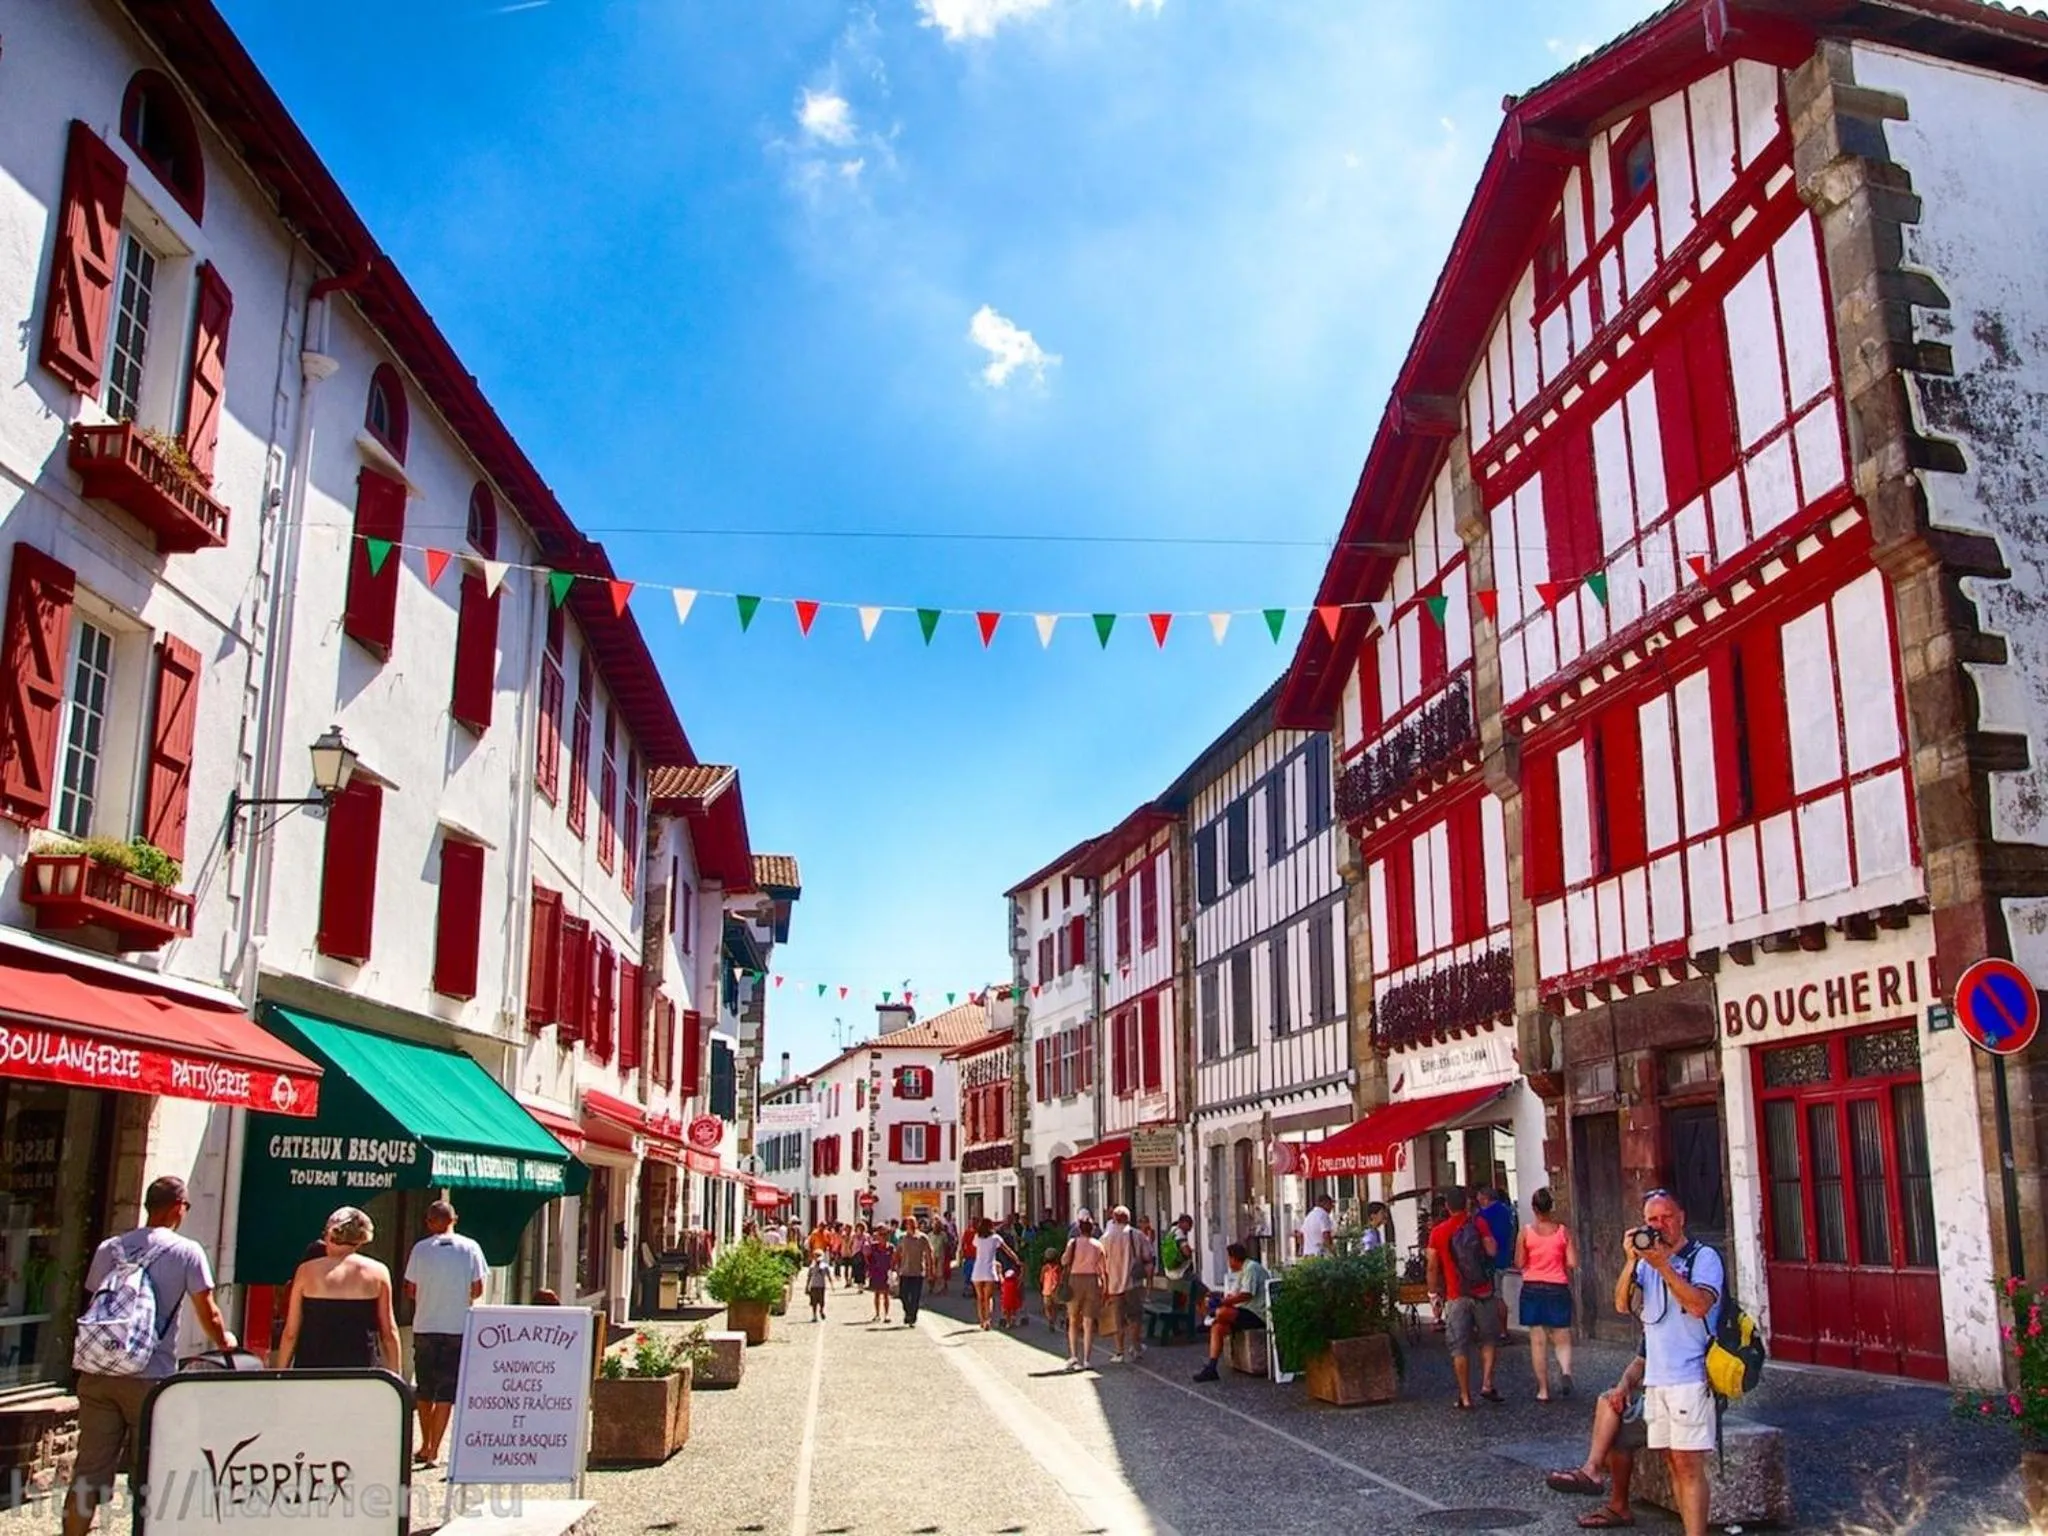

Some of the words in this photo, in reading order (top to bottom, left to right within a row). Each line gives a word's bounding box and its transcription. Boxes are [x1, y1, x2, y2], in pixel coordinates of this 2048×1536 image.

[171, 1058, 250, 1097] PATISSERIE
[269, 1134, 343, 1160] GATEAUX
[348, 1138, 417, 1167] BASQUES
[291, 1169, 338, 1186] TOURON
[492, 1360, 556, 1374] SANDWICHS
[502, 1379, 543, 1392] GLACES
[468, 1396, 520, 1410] BOISSONS
[512, 1415, 526, 1429] ET
[465, 1431, 516, 1447] GÂTEAUX
[519, 1433, 568, 1448] BASQUES
[492, 1452, 537, 1466] MAISON
